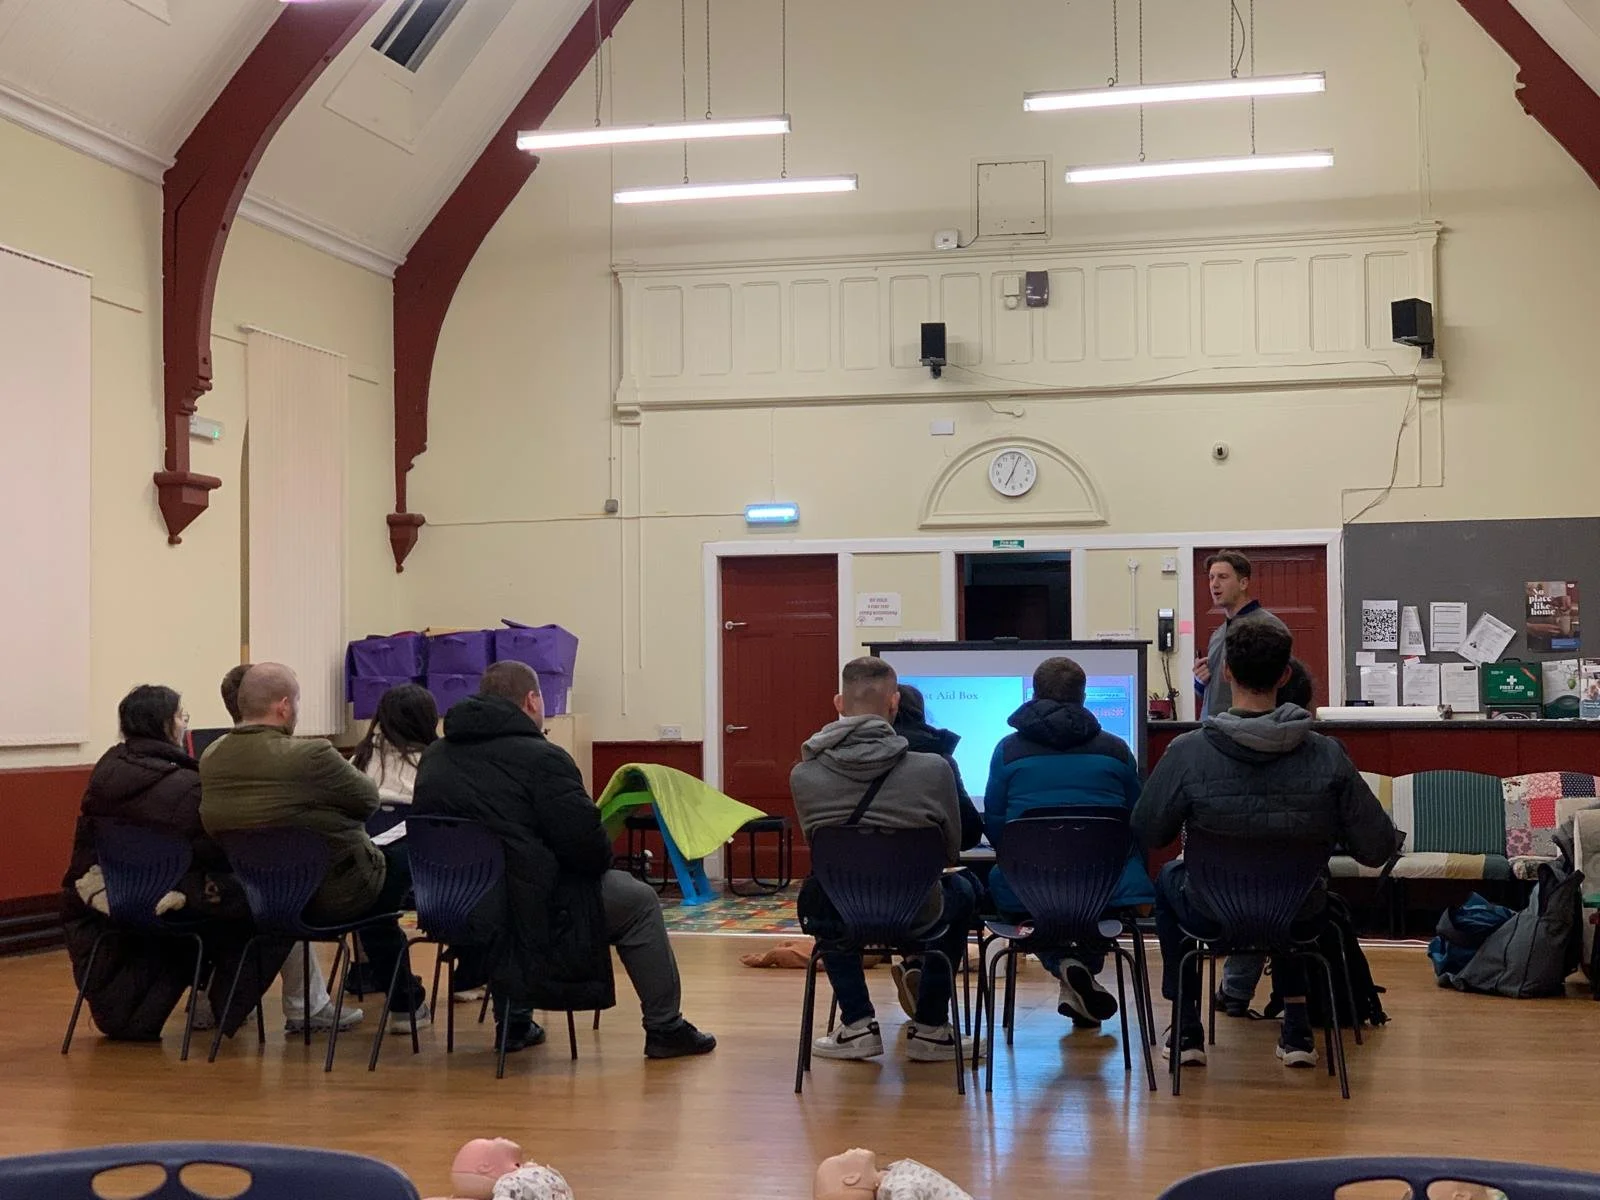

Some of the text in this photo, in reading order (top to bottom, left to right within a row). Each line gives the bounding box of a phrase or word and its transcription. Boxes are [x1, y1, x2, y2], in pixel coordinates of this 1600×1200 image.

[1528, 594, 1552, 605] place
[1533, 602, 1551, 610] like
[1530, 608, 1556, 616] home
[936, 691, 956, 700] Aid
[959, 691, 979, 700] Box
